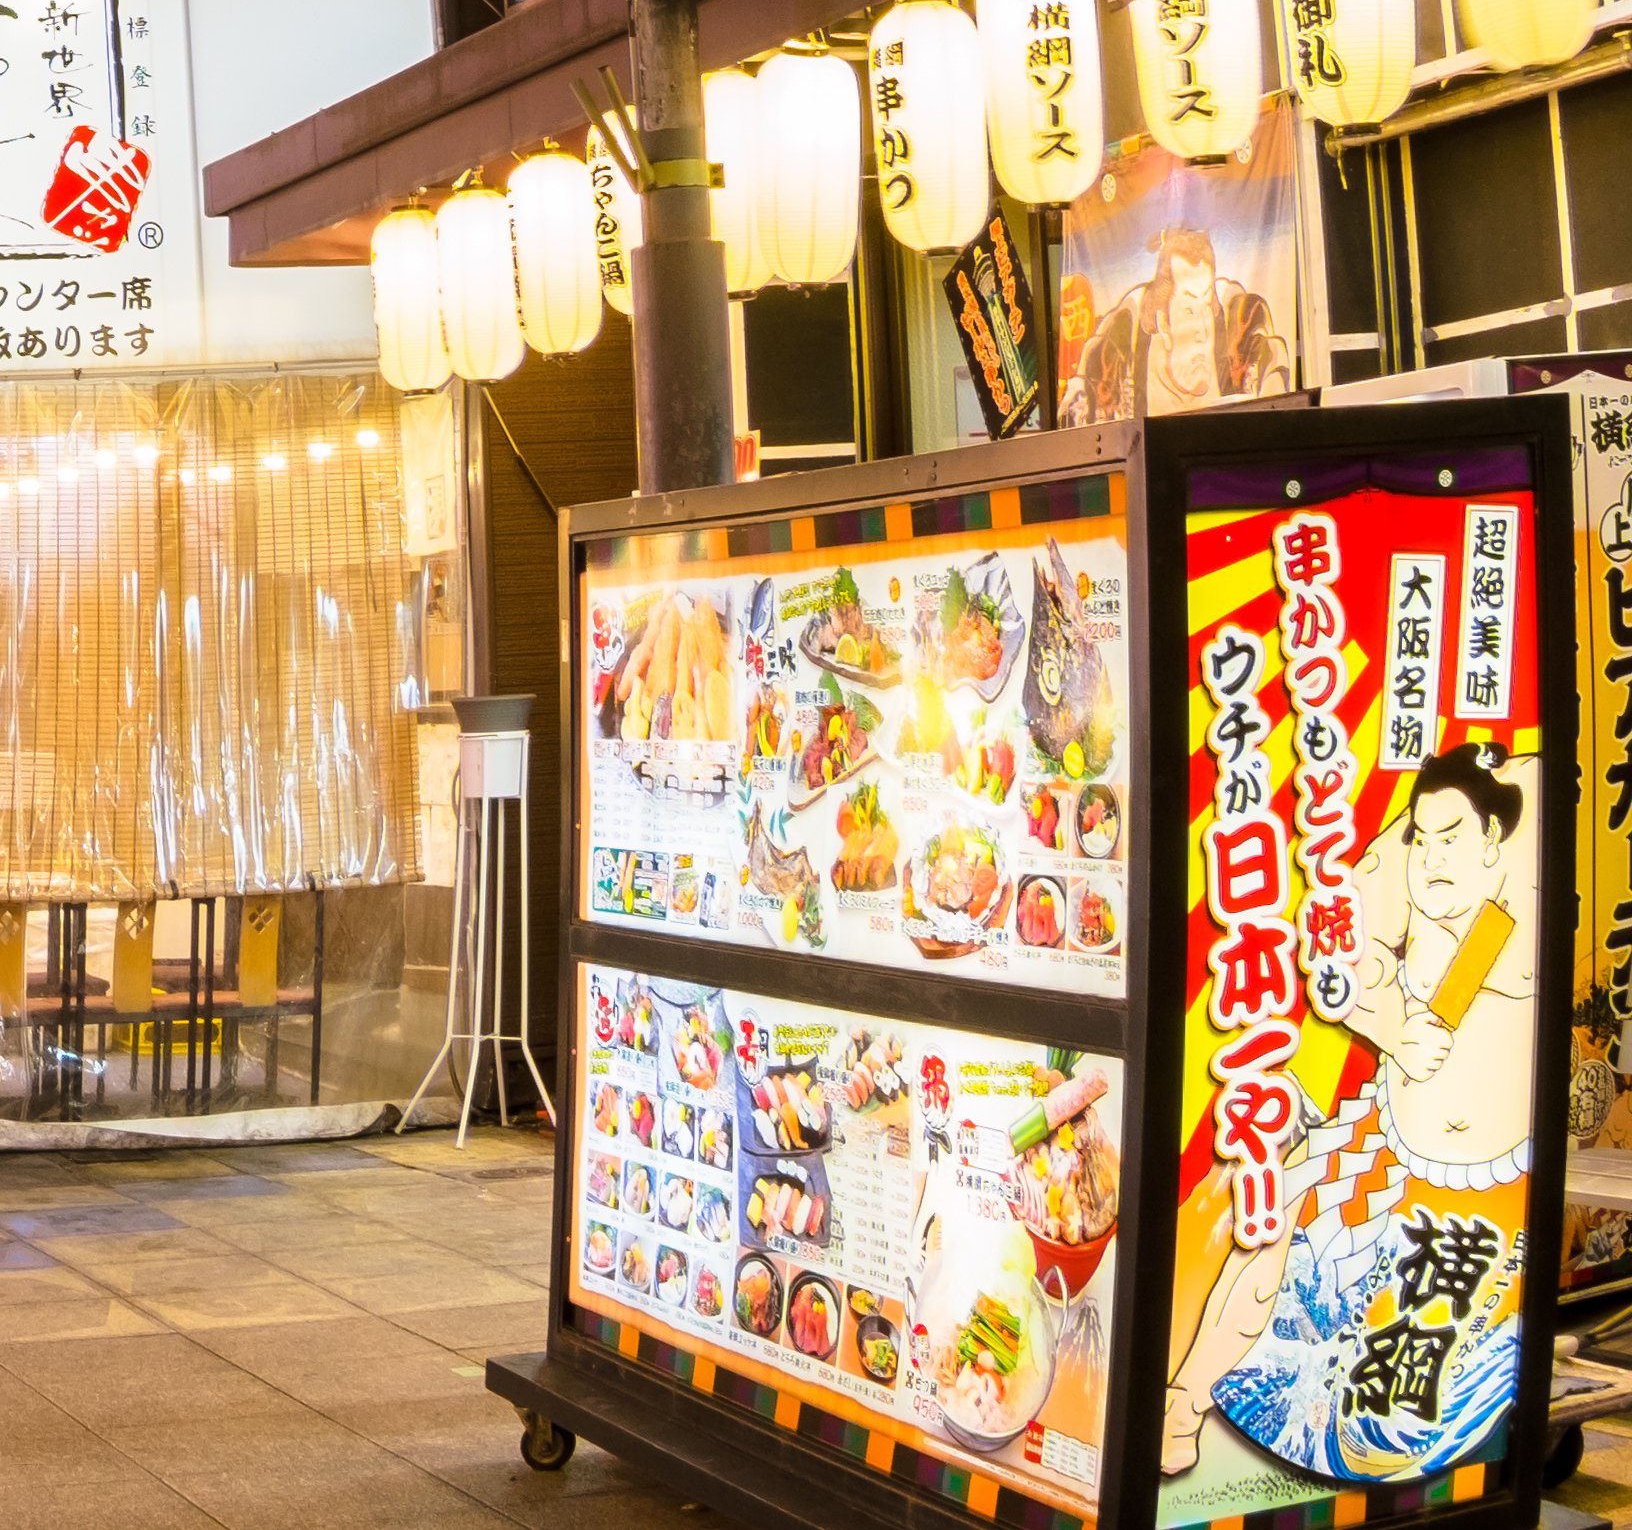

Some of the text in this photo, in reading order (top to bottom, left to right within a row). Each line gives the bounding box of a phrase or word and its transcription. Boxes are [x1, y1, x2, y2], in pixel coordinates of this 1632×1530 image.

[38, 0, 94, 120] 新世界
[876, 74, 916, 212] 串かつ
[1026, 2, 1078, 160] 横綱ソース
[590, 162, 626, 286] ちゃんこ鍋
[1390, 566, 1433, 762] 大阪名物
[1465, 515, 1508, 710] 超絶美味
[1281, 520, 1354, 1012] 串かつもどて焼も
[1207, 634, 1296, 1245] ウチが日本一や!!
[1342, 1207, 1501, 1423] 横綱
